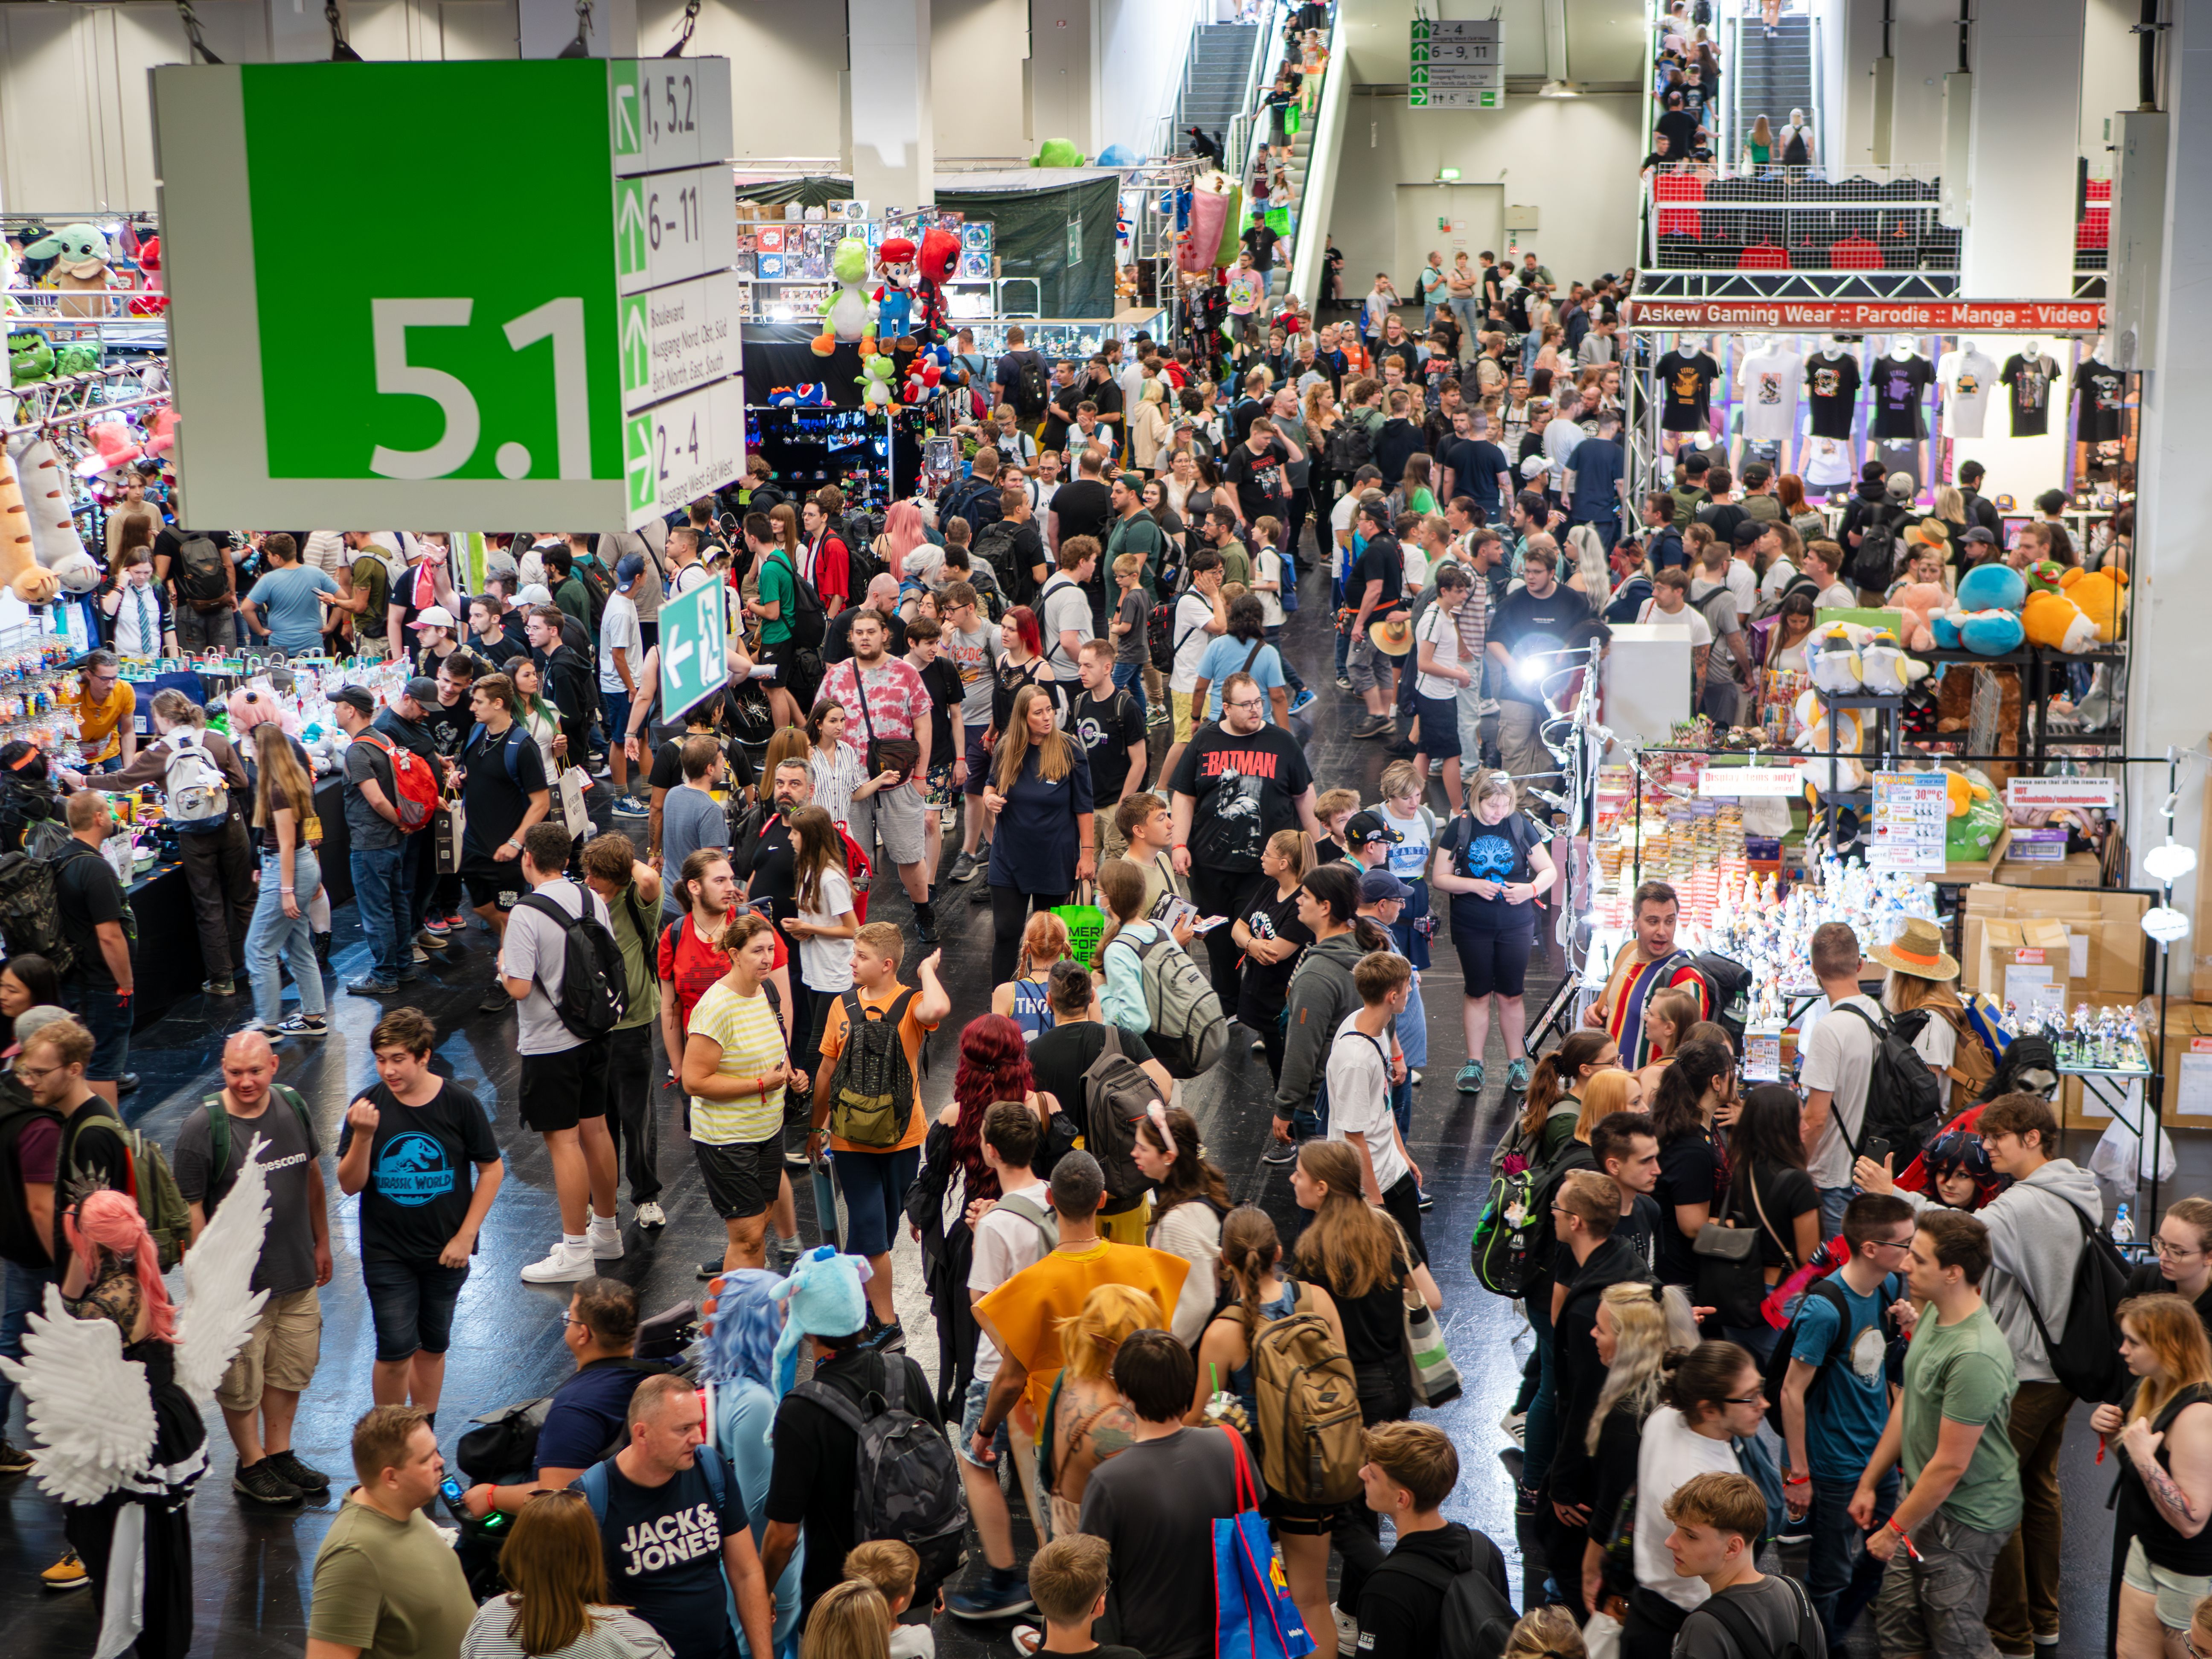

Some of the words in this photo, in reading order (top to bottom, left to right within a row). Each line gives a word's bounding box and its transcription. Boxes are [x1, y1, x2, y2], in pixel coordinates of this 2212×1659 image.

[1432, 24, 1440, 35] 2
[1454, 24, 1463, 35] 4
[1431, 46, 1440, 58] 6
[1473, 46, 1487, 58] 11
[643, 77, 659, 145] 1,
[666, 75, 694, 134] 5.2
[649, 192, 661, 251] 6
[680, 186, 698, 243] 11
[651, 300, 684, 329] Boulevard
[1638, 305, 1701, 321] Askew
[1707, 305, 1779, 326] Gaming
[1785, 306, 1835, 323] Wear
[1856, 306, 1930, 323] Parodie
[1952, 307, 2015, 327] Manga
[2037, 306, 2092, 323] Video
[652, 330, 680, 361] Ausgang
[653, 370, 665, 394] Exit
[706, 350, 724, 375] South
[369, 297, 593, 480] 5.1
[657, 424, 668, 481] 2
[689, 411, 699, 465] 4
[660, 480, 687, 508] Ausgang
[688, 470, 704, 493] West
[706, 464, 718, 484] Exit
[719, 458, 733, 477] West
[1207, 751, 1278, 779] BATMAN
[1705, 772, 1739, 783] Display
[1743, 772, 1769, 782] items
[1773, 772, 1796, 783] only!
[1875, 774, 1915, 785] FIGURE
[2014, 795, 2108, 804] refundable/exchangeable.
[1392, 847, 1427, 856] KANTO
[1069, 939, 1099, 949] FOR
[1072, 952, 1096, 962] NER
[1016, 997, 1052, 1014] THO
[236, 1152, 307, 1178] mescom
[414, 1173, 452, 1190] WORLD
[620, 1502, 718, 1552] JACK&
[625, 1524, 722, 1576] JONES
